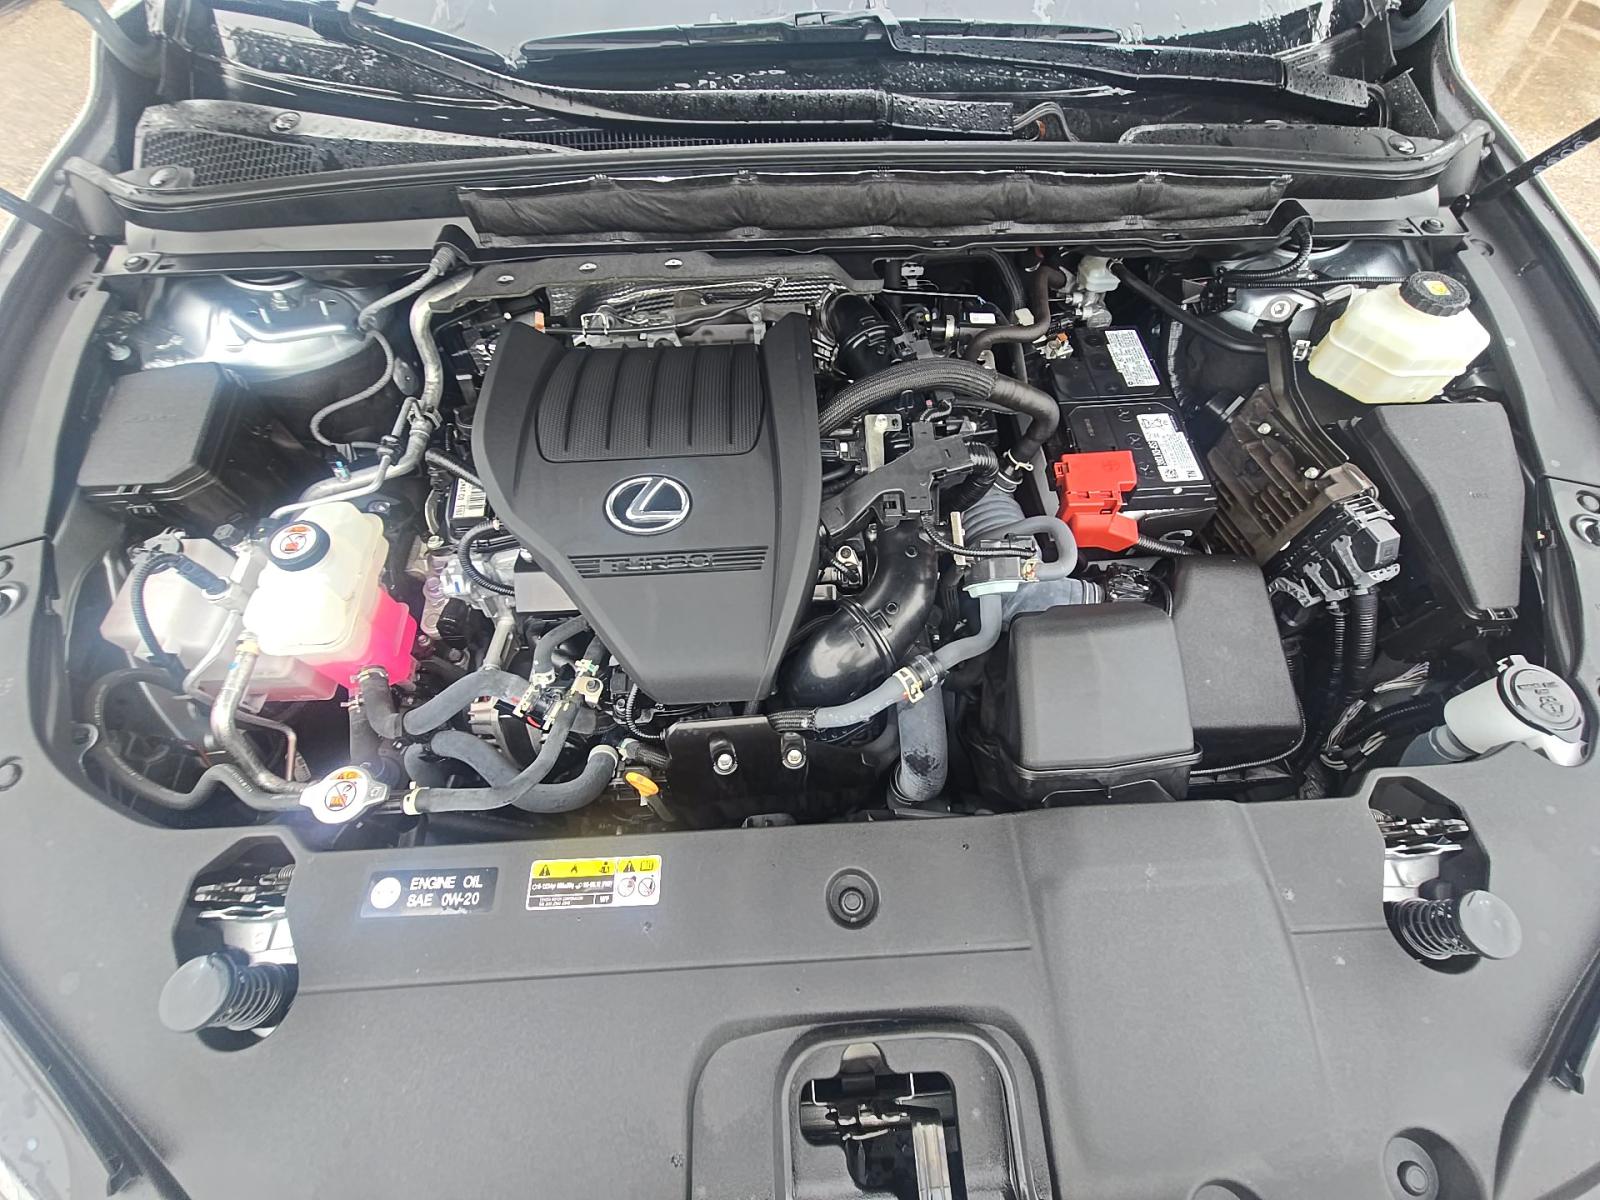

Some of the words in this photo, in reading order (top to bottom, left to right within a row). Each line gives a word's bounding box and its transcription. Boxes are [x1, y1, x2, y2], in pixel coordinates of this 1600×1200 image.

[602, 553, 712, 572] TURBO
[410, 876, 456, 890] ENGINE
[463, 875, 483, 889] OIL
[406, 893, 433, 908] SAE
[441, 891, 480, 906] 0W-20
